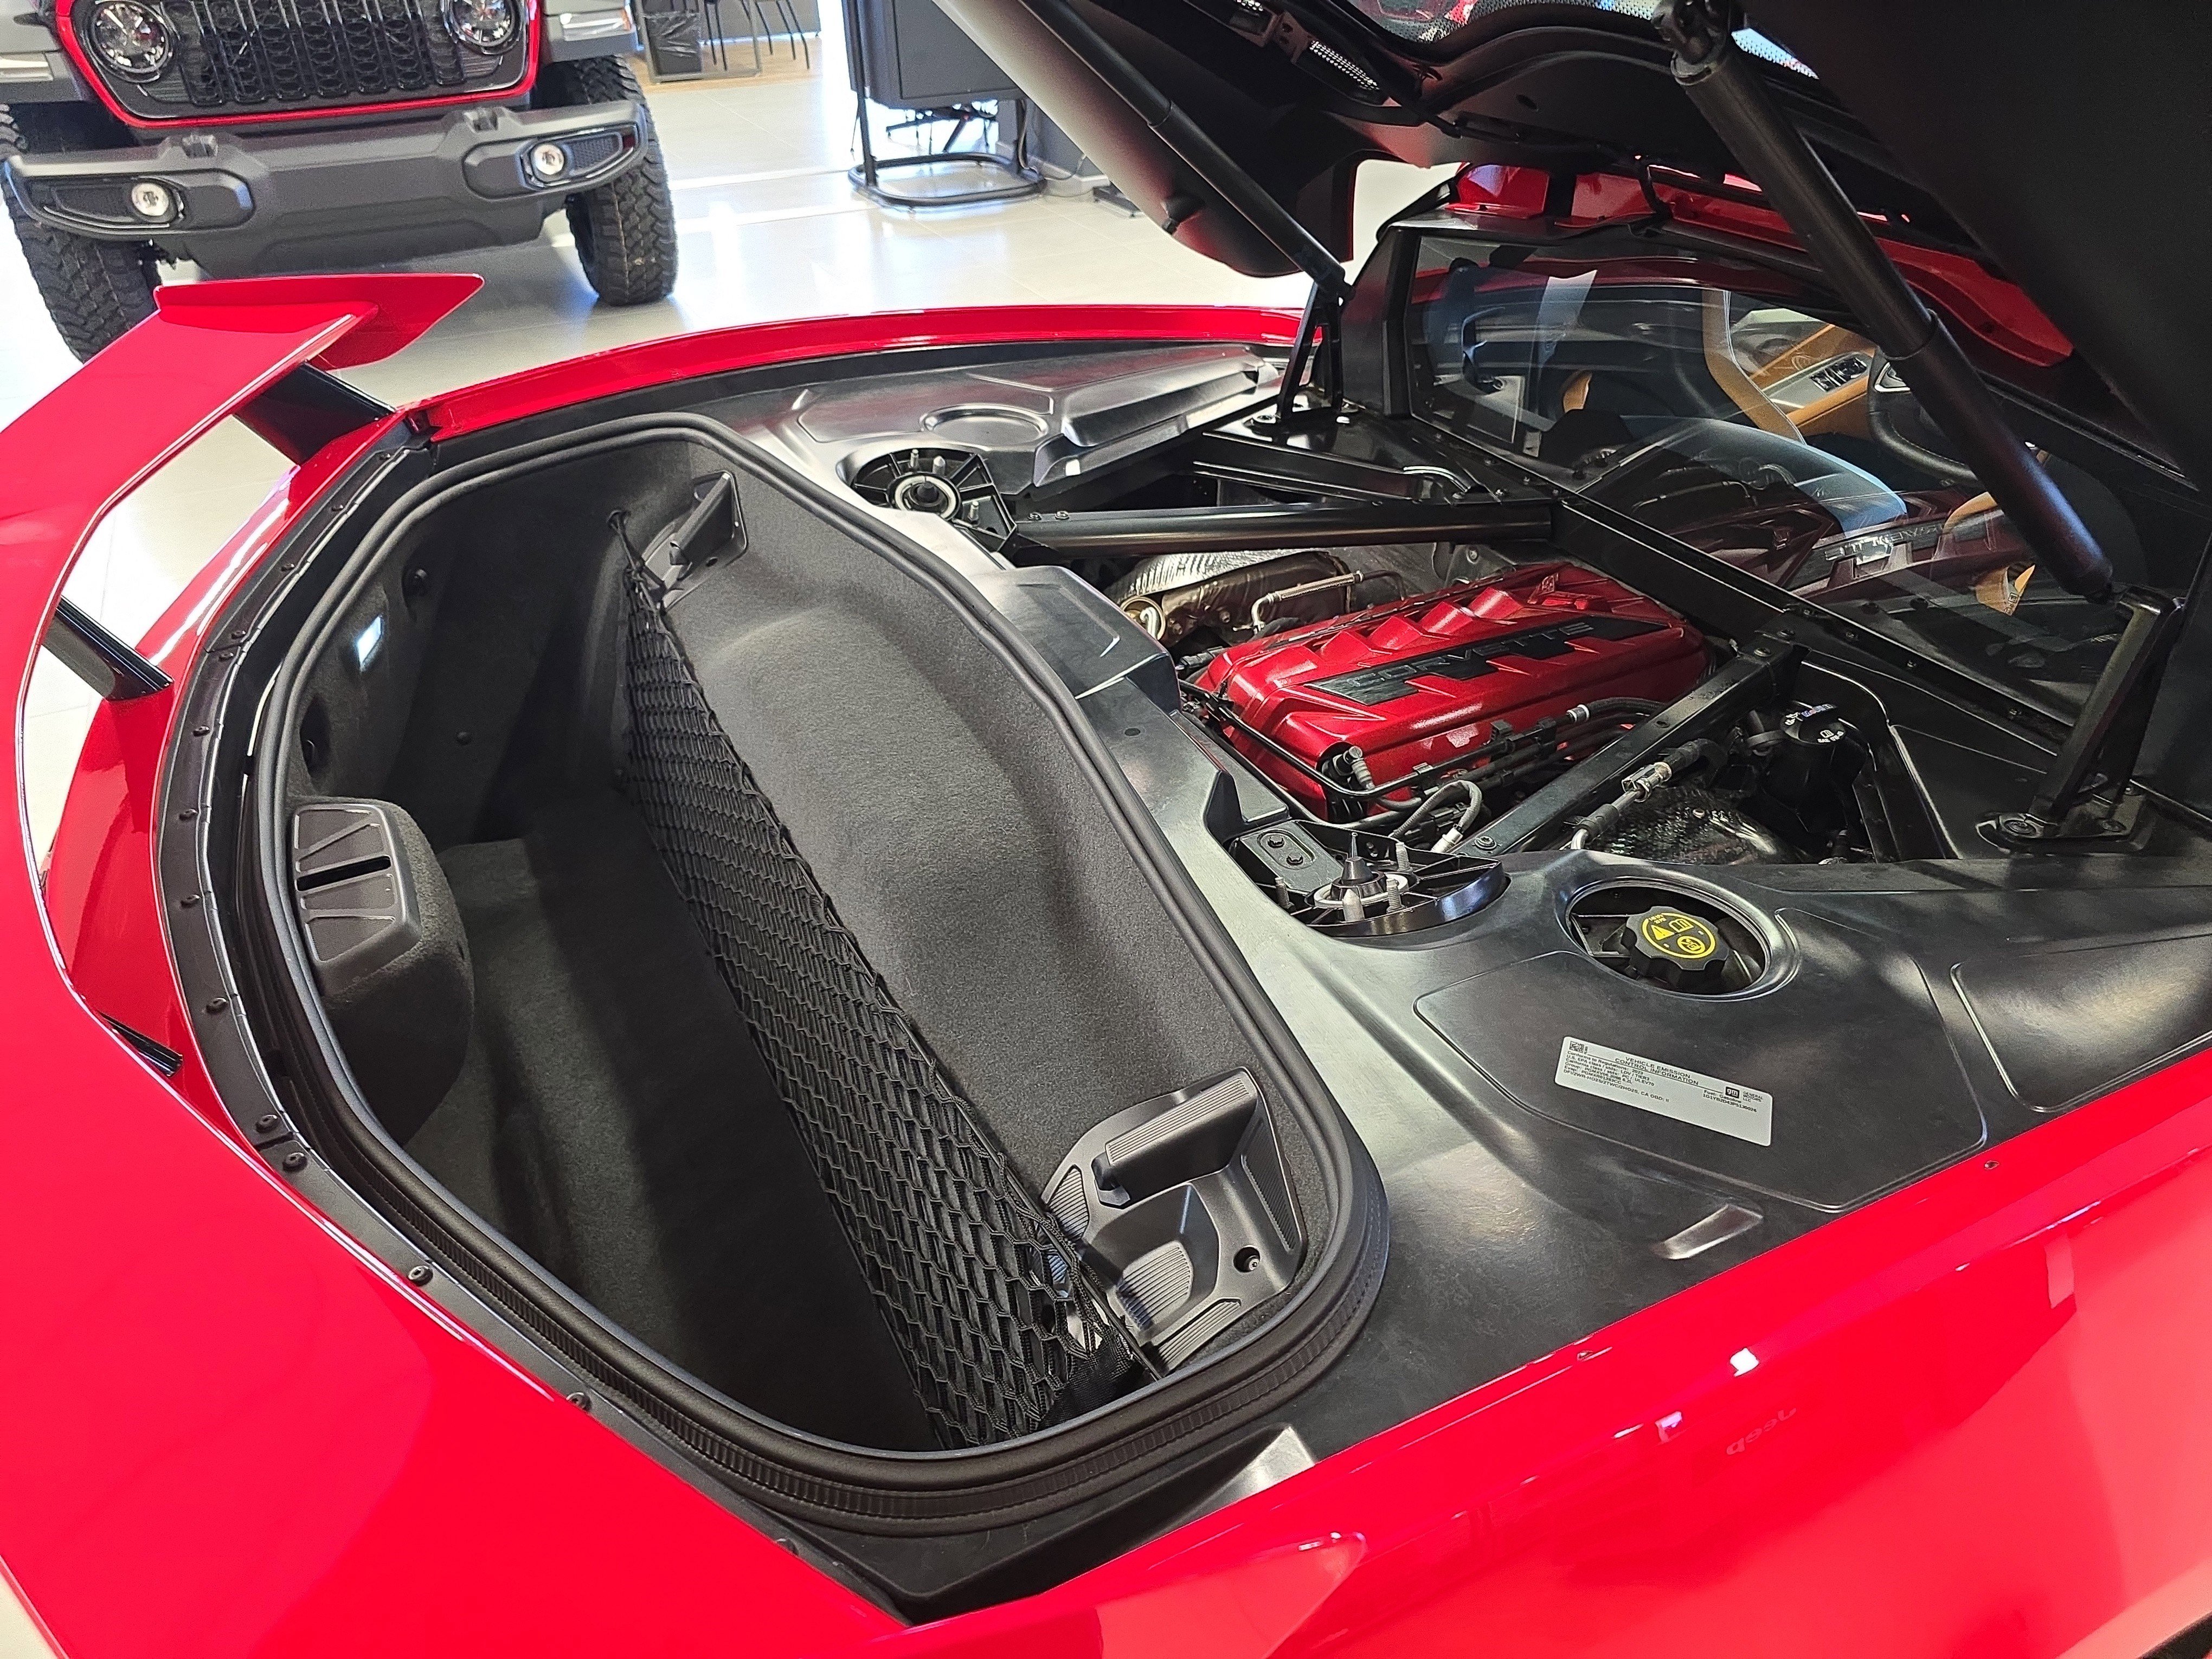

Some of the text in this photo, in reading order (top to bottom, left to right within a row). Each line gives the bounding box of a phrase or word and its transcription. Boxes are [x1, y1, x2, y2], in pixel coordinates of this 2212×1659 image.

[1347, 621, 1594, 688] CORVETTE
[1567, 1050, 1591, 1060] Conforms
[1625, 1056, 1690, 1078] VEHICLE EMISSION
[1615, 1058, 1698, 1085] CONTROL INFORMATION
